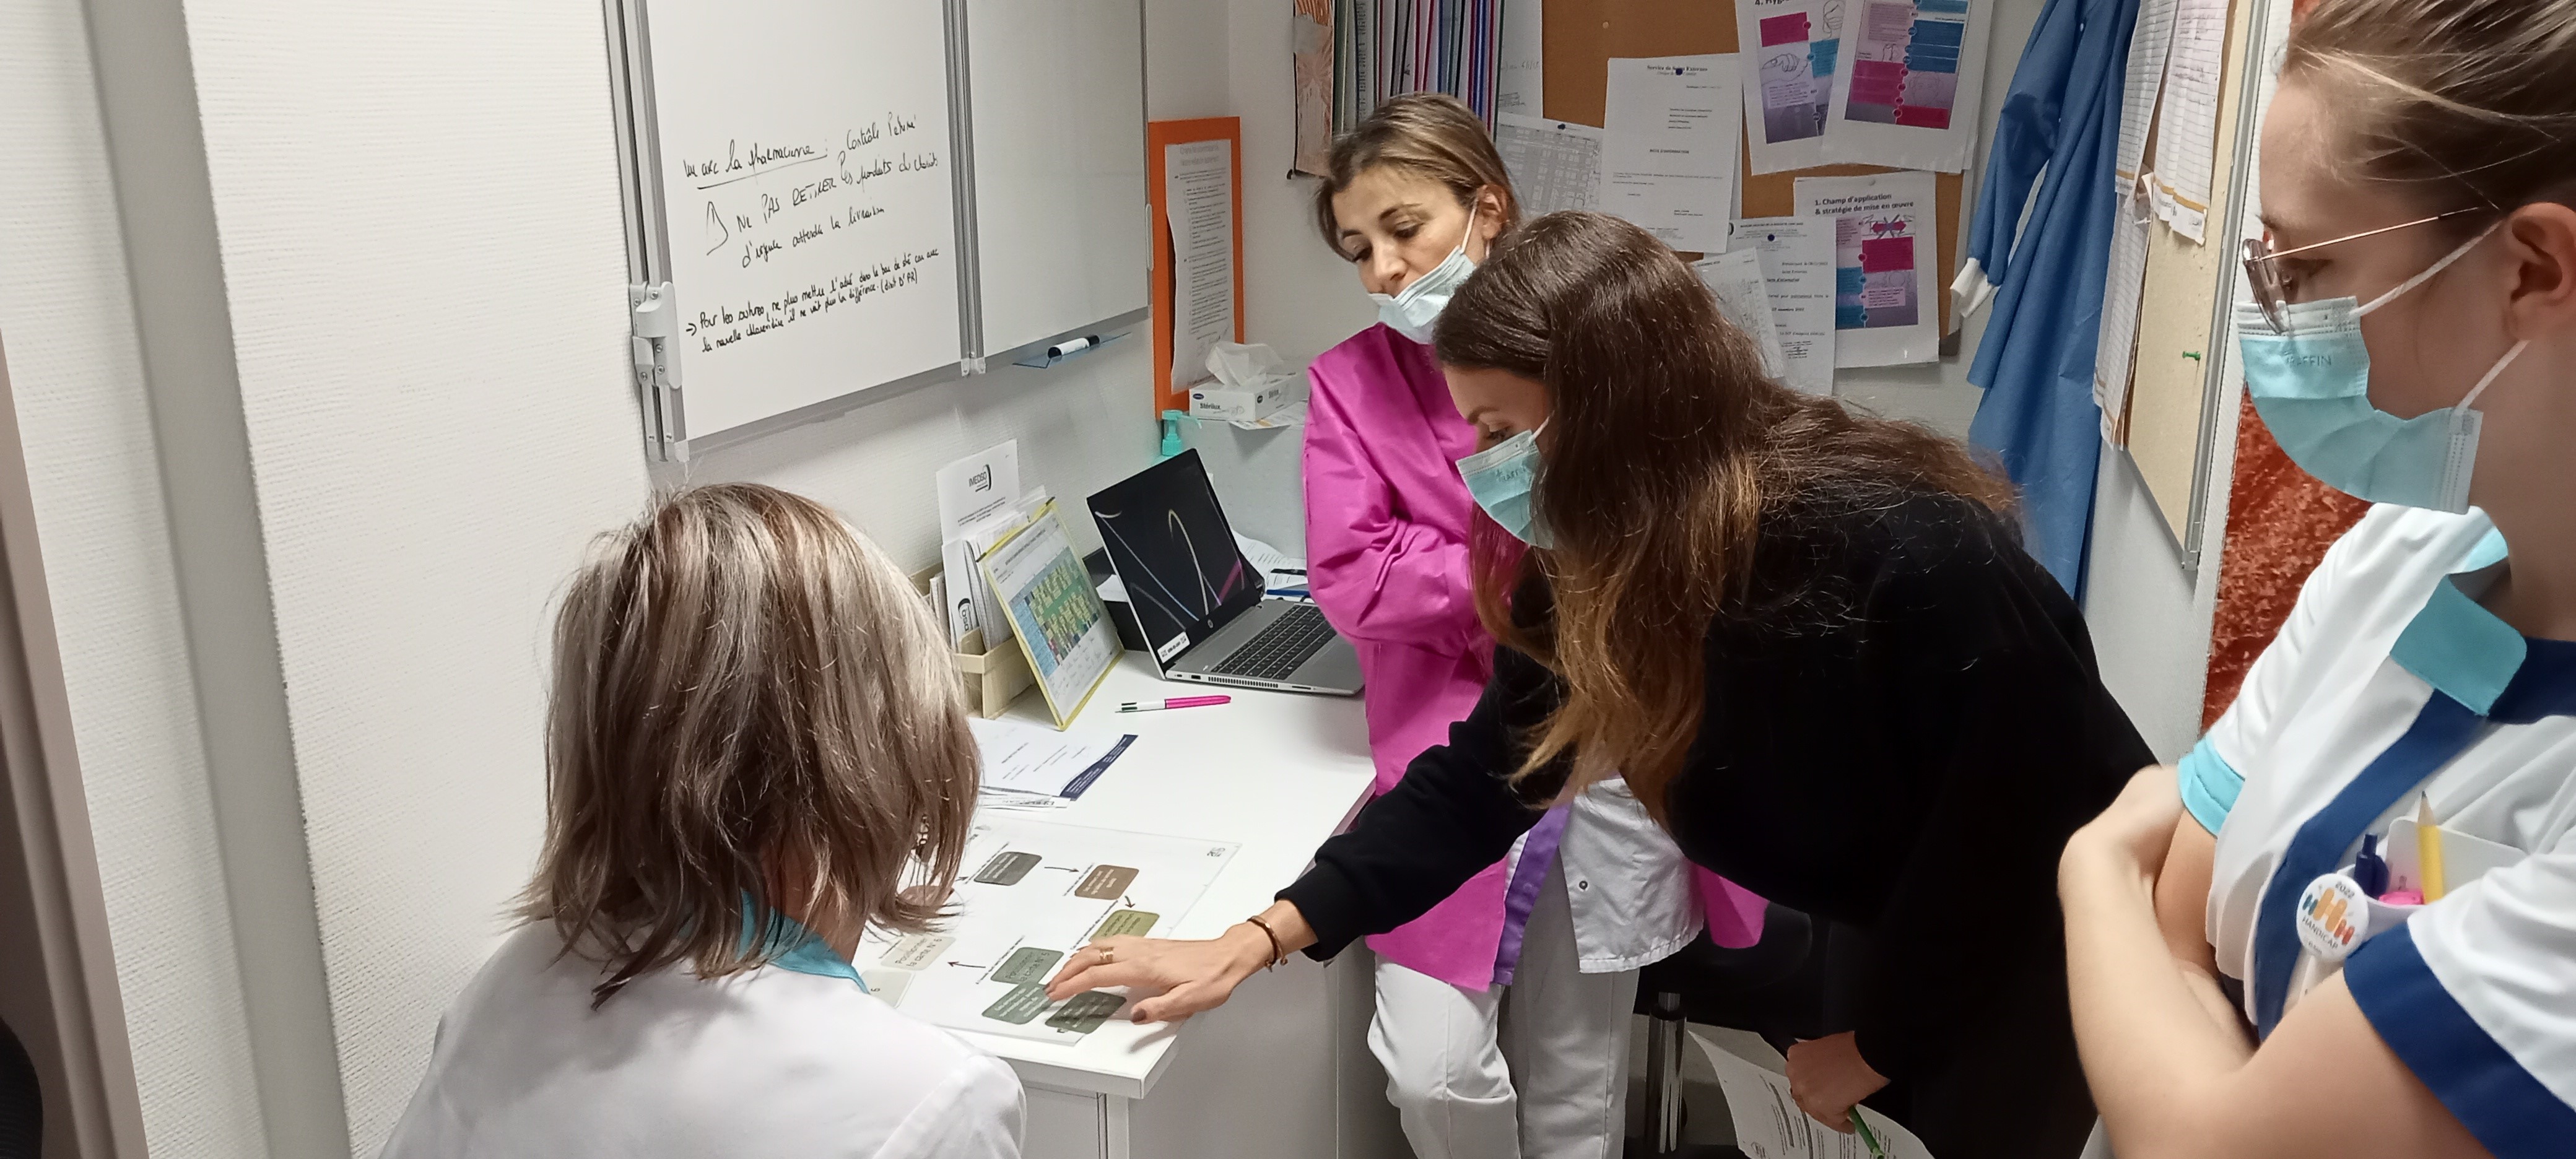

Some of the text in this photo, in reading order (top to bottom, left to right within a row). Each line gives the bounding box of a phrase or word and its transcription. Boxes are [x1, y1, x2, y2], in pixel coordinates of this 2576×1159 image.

[725, 139, 742, 173] la
[761, 193, 780, 224] PAS
[792, 178, 837, 207] RETIRER
[1822, 196, 1847, 205] Champ
[1847, 193, 1892, 204] d'application
[1822, 205, 1852, 215] stratégie
[1863, 203, 1880, 211] mise
[1891, 201, 1914, 209] œuvre
[700, 311, 718, 329] Pour
[721, 305, 733, 324] les
[772, 301, 781, 311] ne
[783, 290, 798, 315] plus
[801, 284, 825, 301] mettre
[702, 336, 713, 353] la
[2335, 880, 2356, 900] 2022
[2302, 916, 2339, 950] HANDICAP
